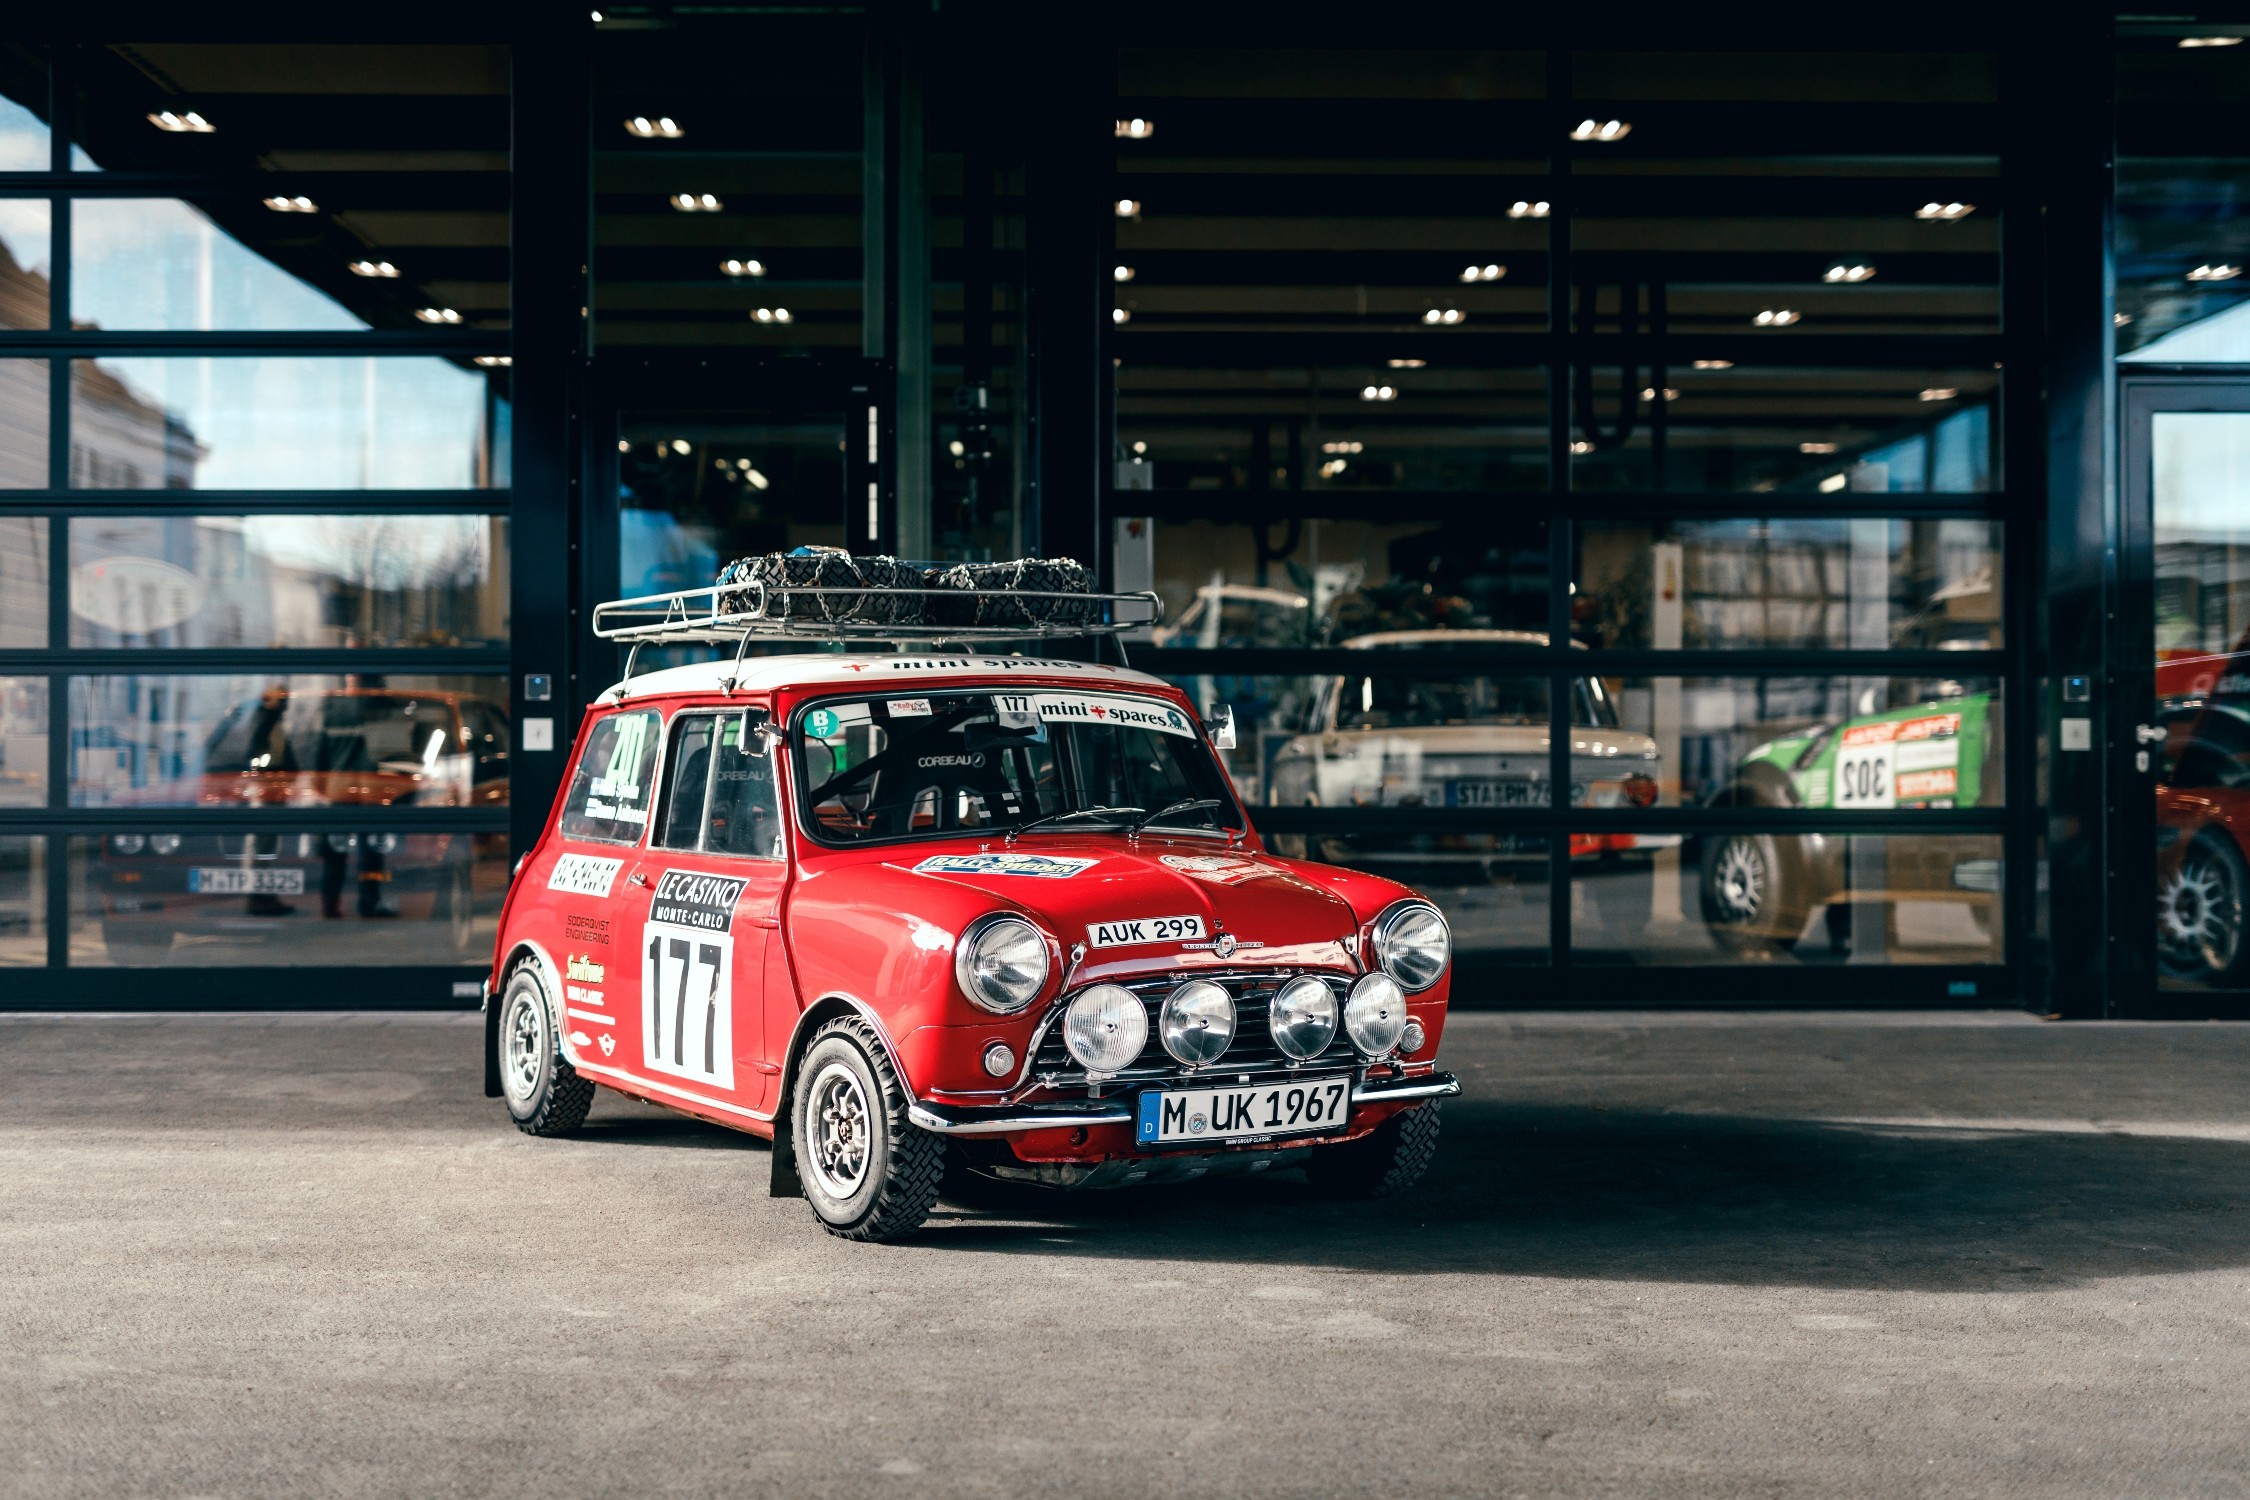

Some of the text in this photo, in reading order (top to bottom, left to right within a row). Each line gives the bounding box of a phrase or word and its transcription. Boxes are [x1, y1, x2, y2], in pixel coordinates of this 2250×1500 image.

[893, 658, 1083, 669] mini spares
[1001, 696, 1028, 711] 177
[1041, 701, 1089, 716] mini
[812, 711, 829, 727] B
[815, 727, 827, 735] 17
[918, 754, 972, 768] CORBEAU
[717, 770, 765, 782] ORBEAU
[1459, 782, 1492, 804] STA
[933, 857, 994, 868] RALLY
[991, 861, 1080, 873] SWEDEN
[656, 873, 740, 908] LE CASINO
[1098, 918, 1199, 944] AUK 299
[1213, 919, 1223, 929] S
[565, 928, 610, 945] ENGINEERING
[649, 935, 722, 1075] 177
[1163, 1084, 1345, 1135] M UK 1967
[1145, 1122, 1153, 1134] D
